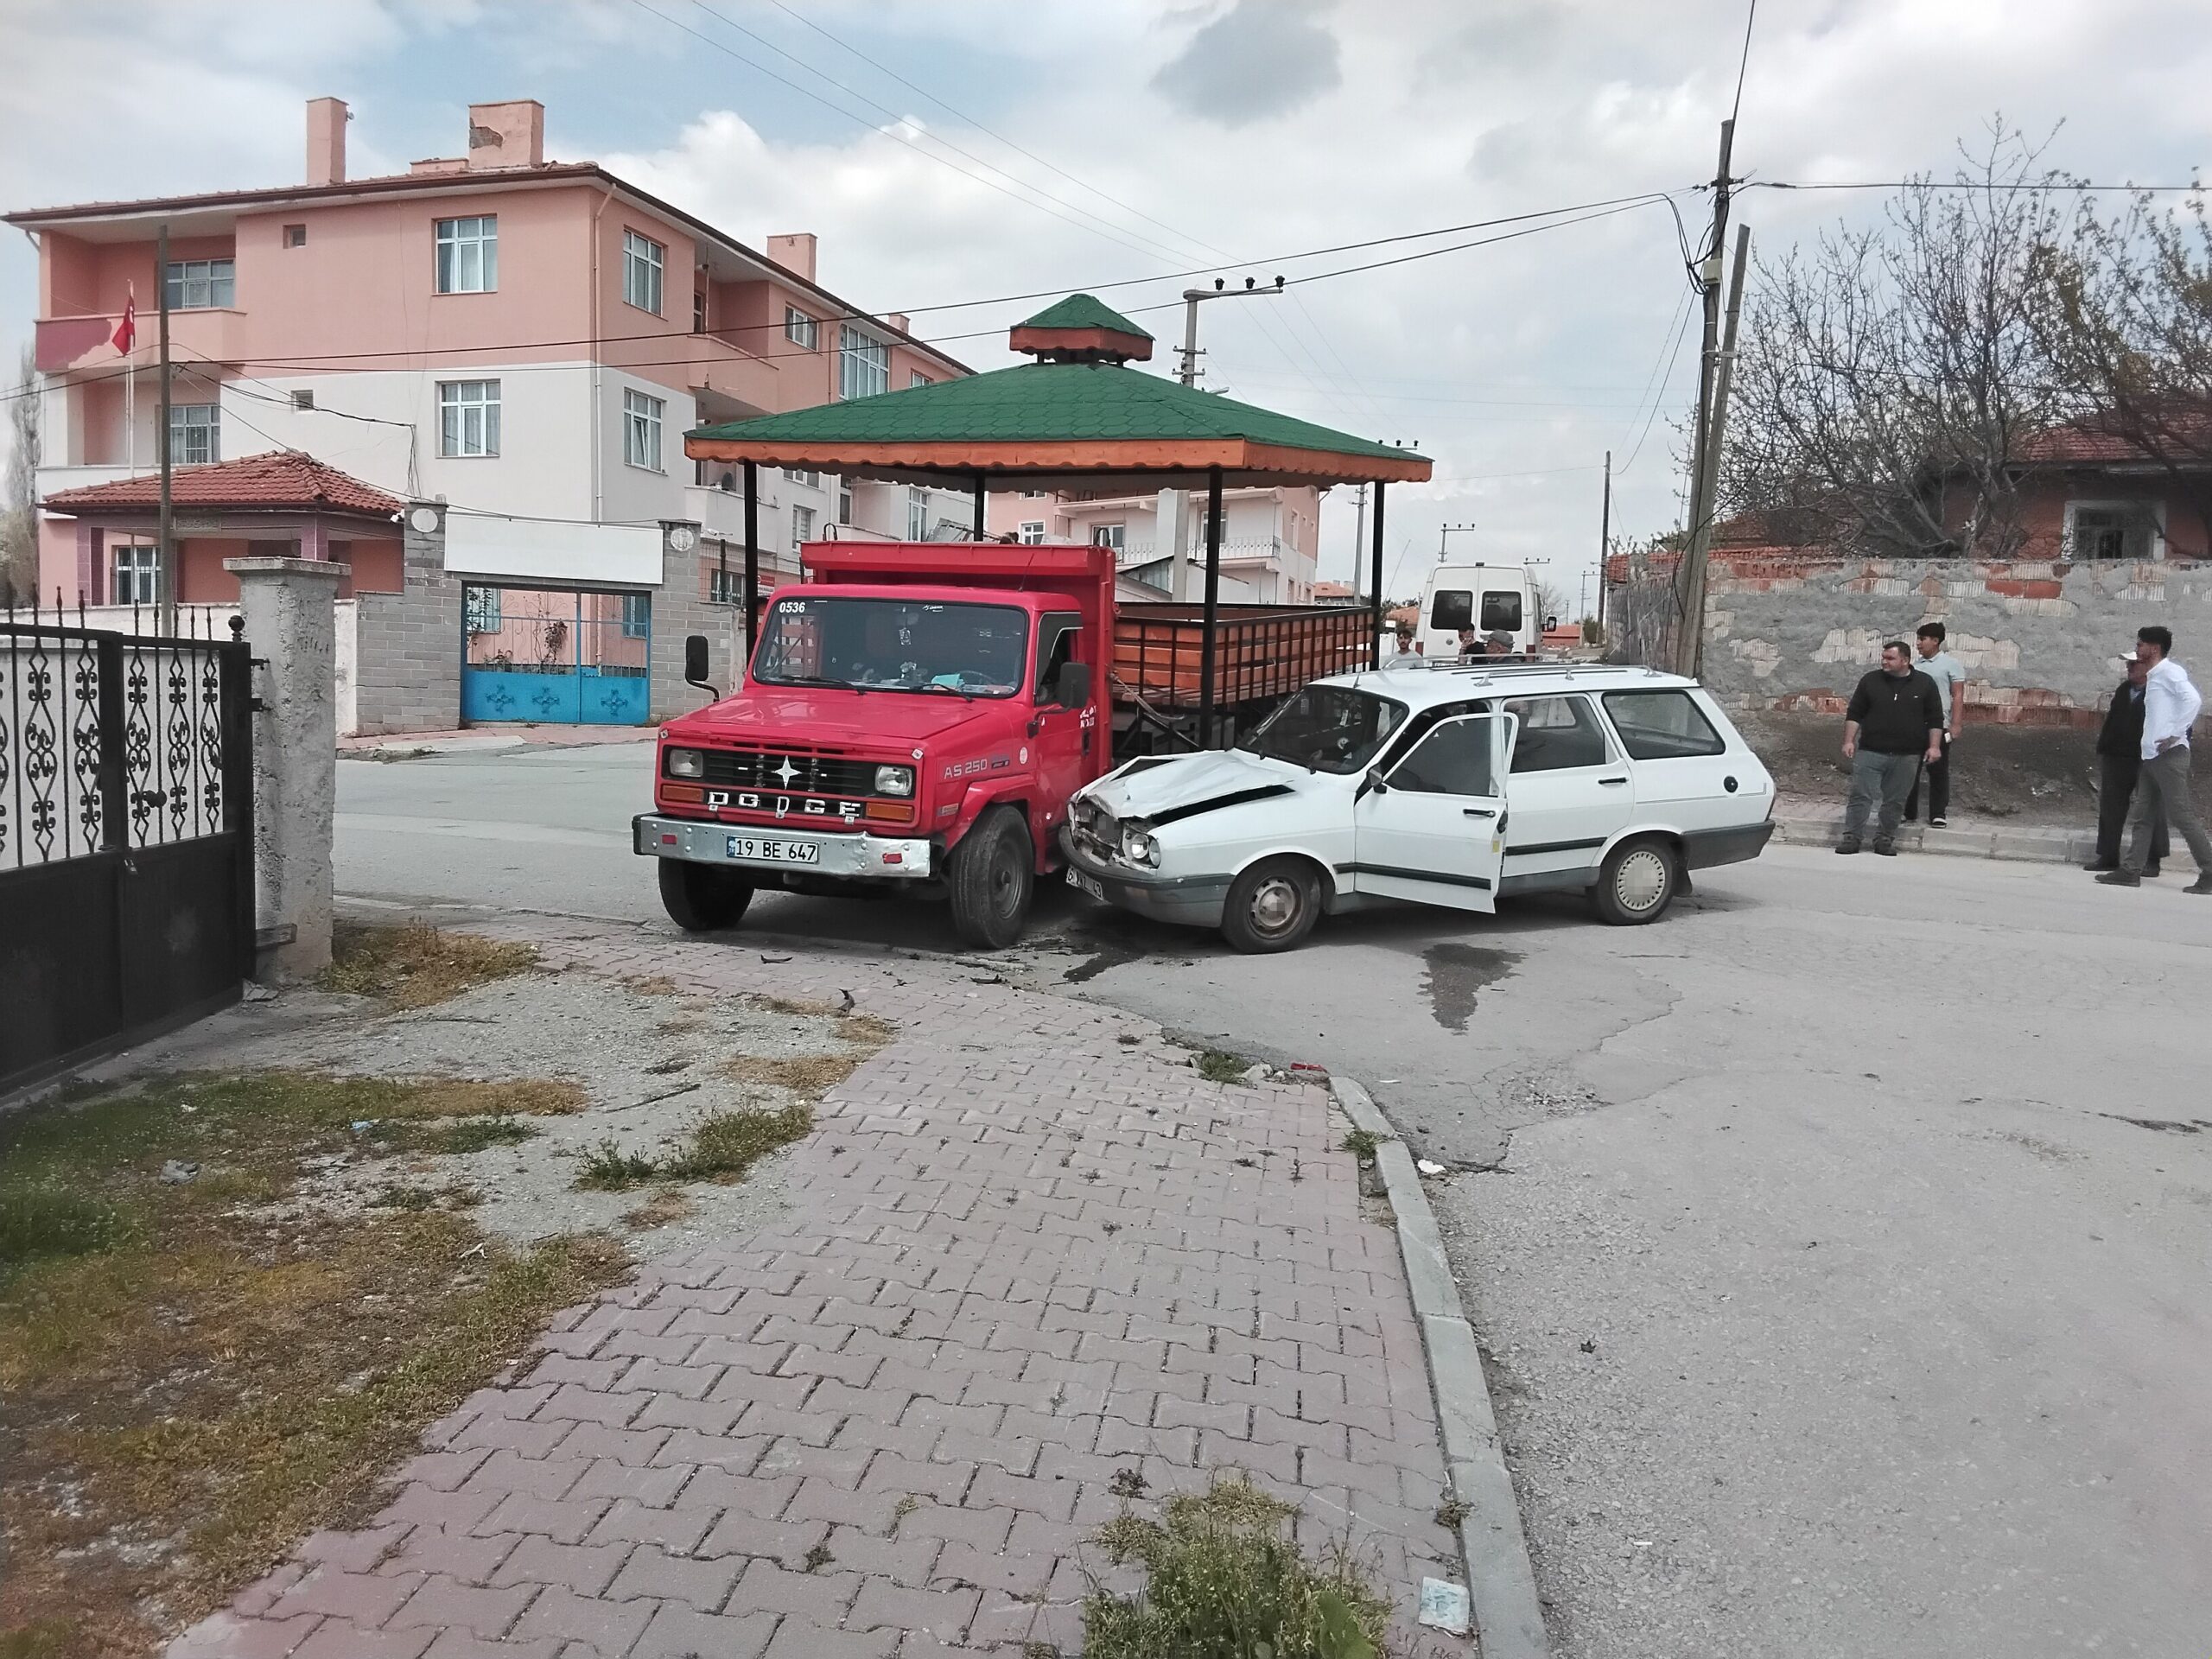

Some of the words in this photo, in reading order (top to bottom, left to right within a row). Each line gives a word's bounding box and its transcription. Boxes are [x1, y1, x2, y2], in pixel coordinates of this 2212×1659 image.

[779, 602, 805, 613] 0536
[944, 764, 962, 779] AS
[965, 759, 988, 774] 250
[708, 791, 861, 817] DODGE
[736, 840, 753, 856] 19
[763, 842, 781, 858] BE
[788, 843, 817, 861] 647
